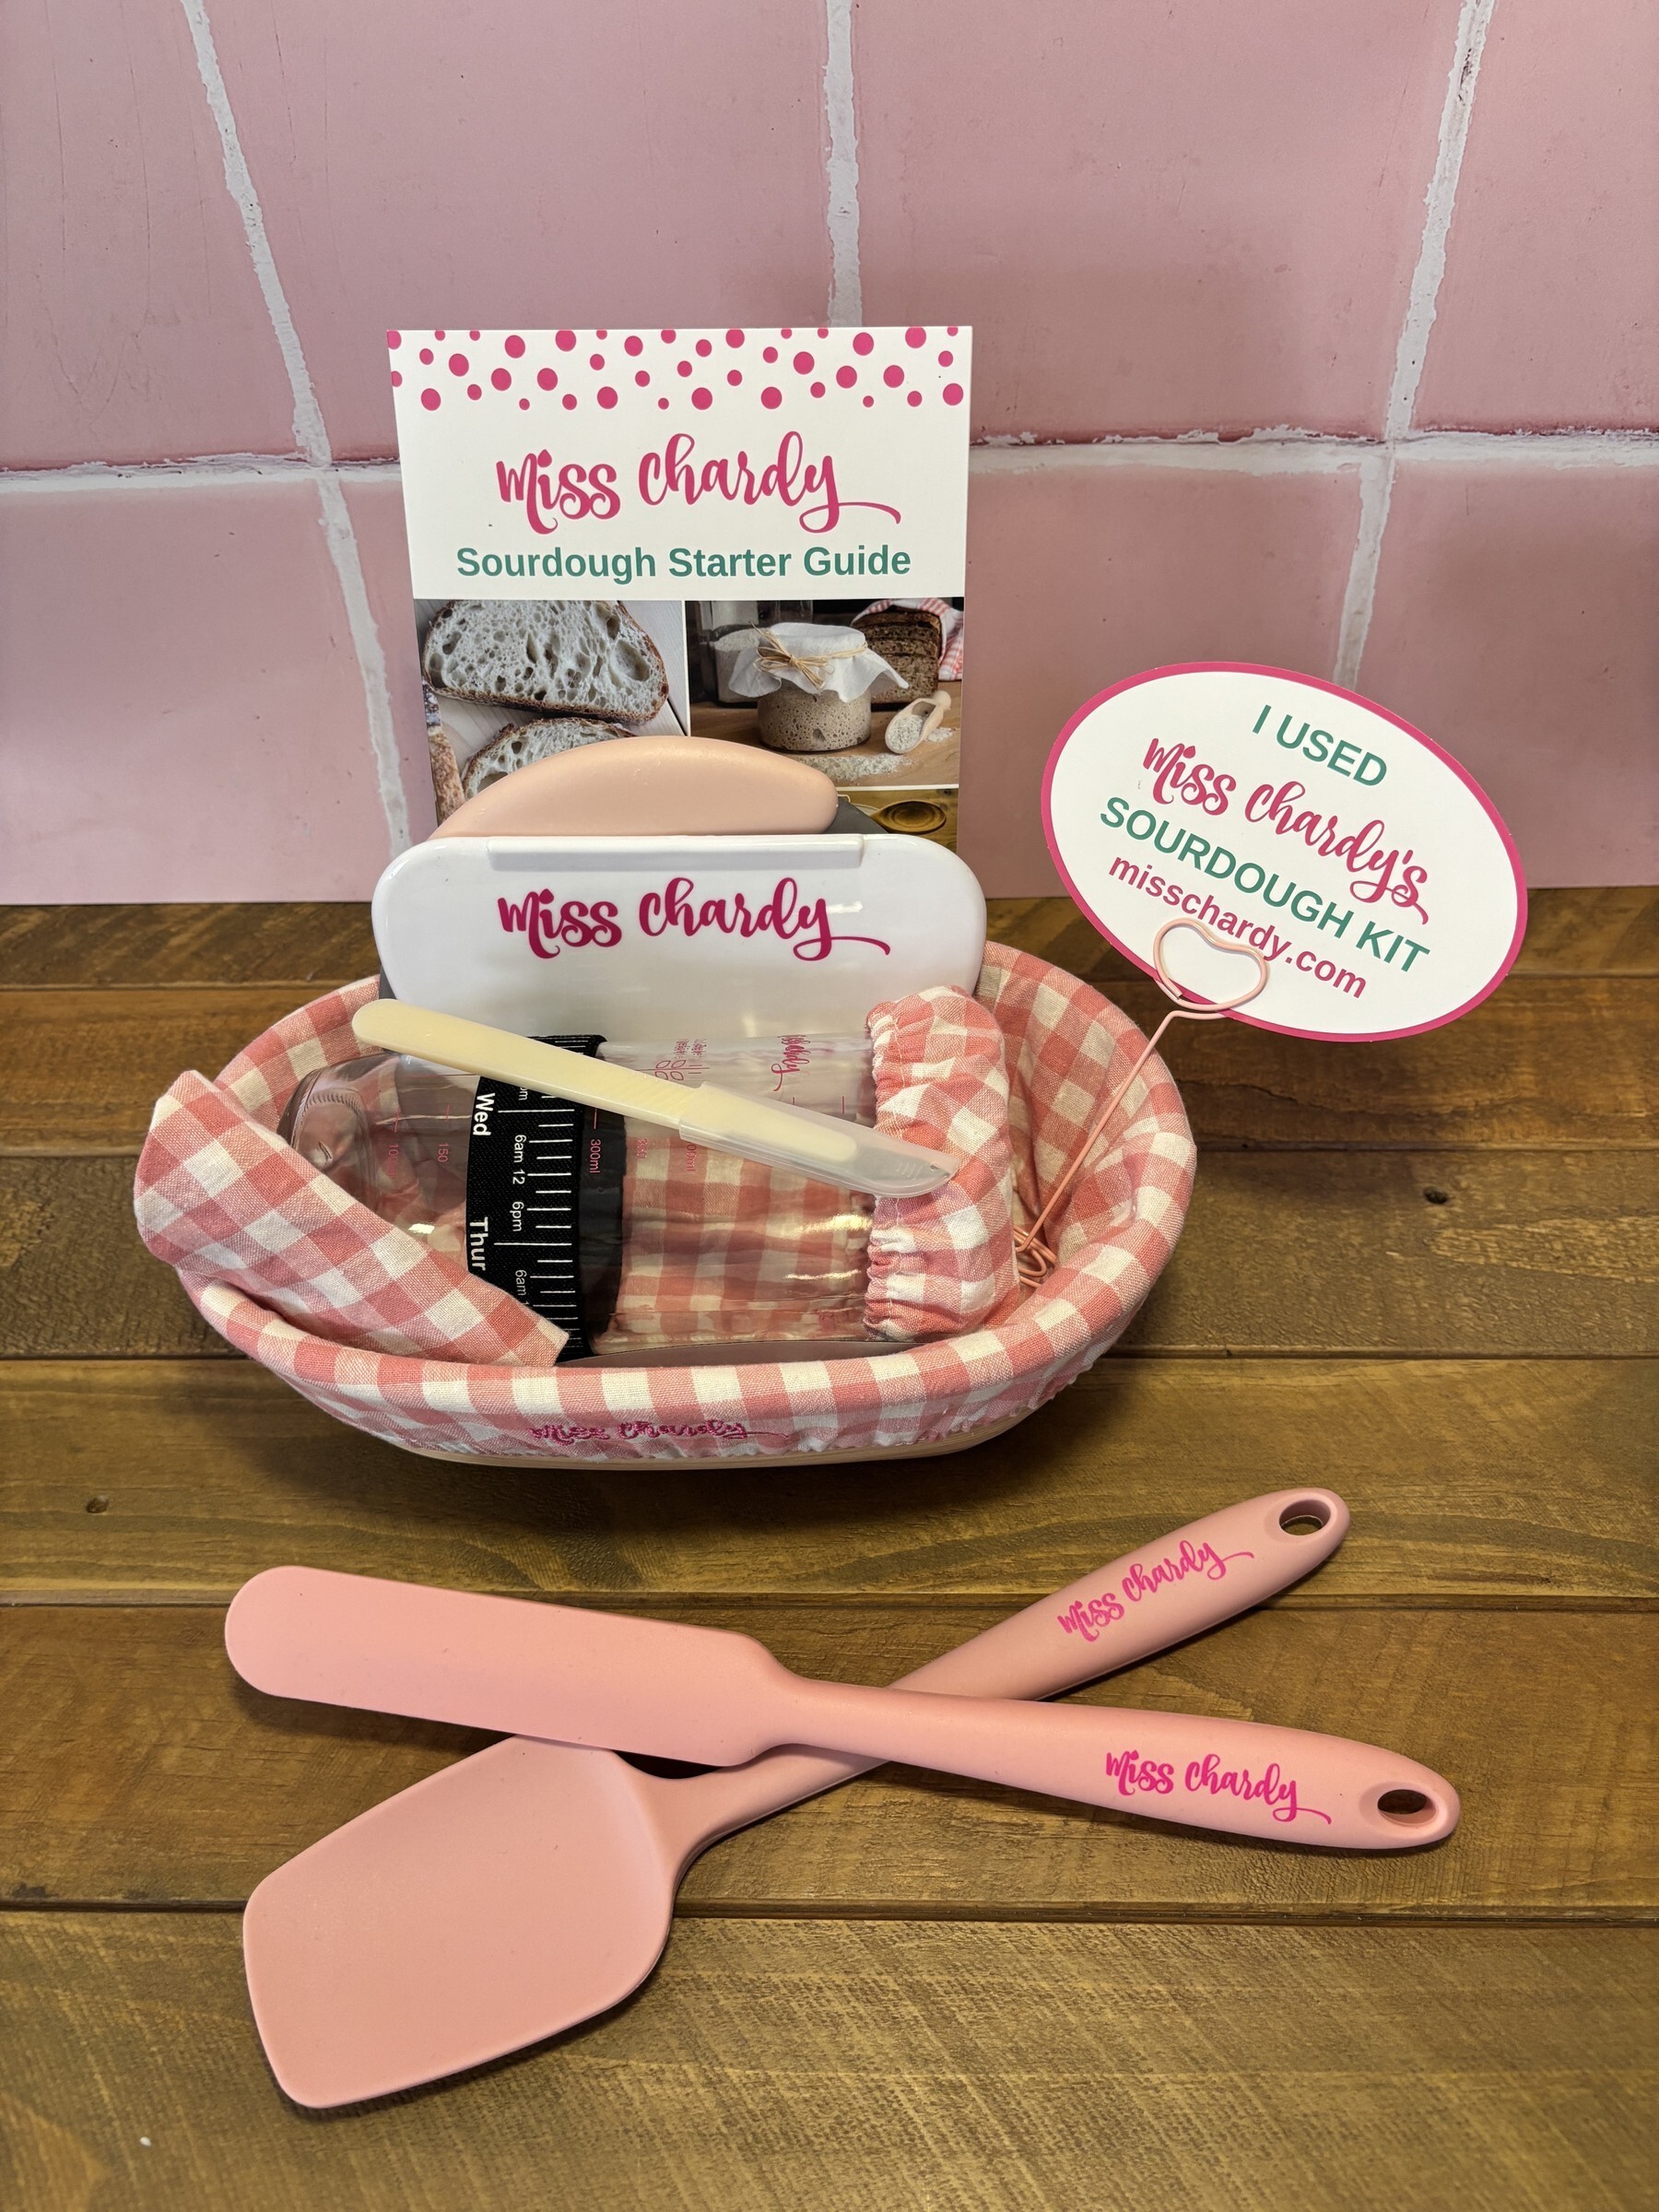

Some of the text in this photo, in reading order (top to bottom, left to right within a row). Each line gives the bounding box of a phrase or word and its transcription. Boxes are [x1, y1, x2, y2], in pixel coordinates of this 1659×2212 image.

[456, 545, 912, 586] Sourdough Starter Guide
[1252, 704, 1388, 787] I USED
[1100, 796, 1430, 973] SOURDOUGH KIT
[1108, 856, 1368, 999] misschardy.com
[437, 1142, 450, 1163] 150
[513, 1134, 527, 1163] 6am
[588, 1138, 602, 1173] 300ml
[686, 1144, 697, 1172] 00ml
[469, 1092, 496, 1271] Wed Thur
[512, 1169, 526, 1185] 12
[509, 1201, 525, 1232] 6pm
[514, 1269, 528, 1296] 6am
